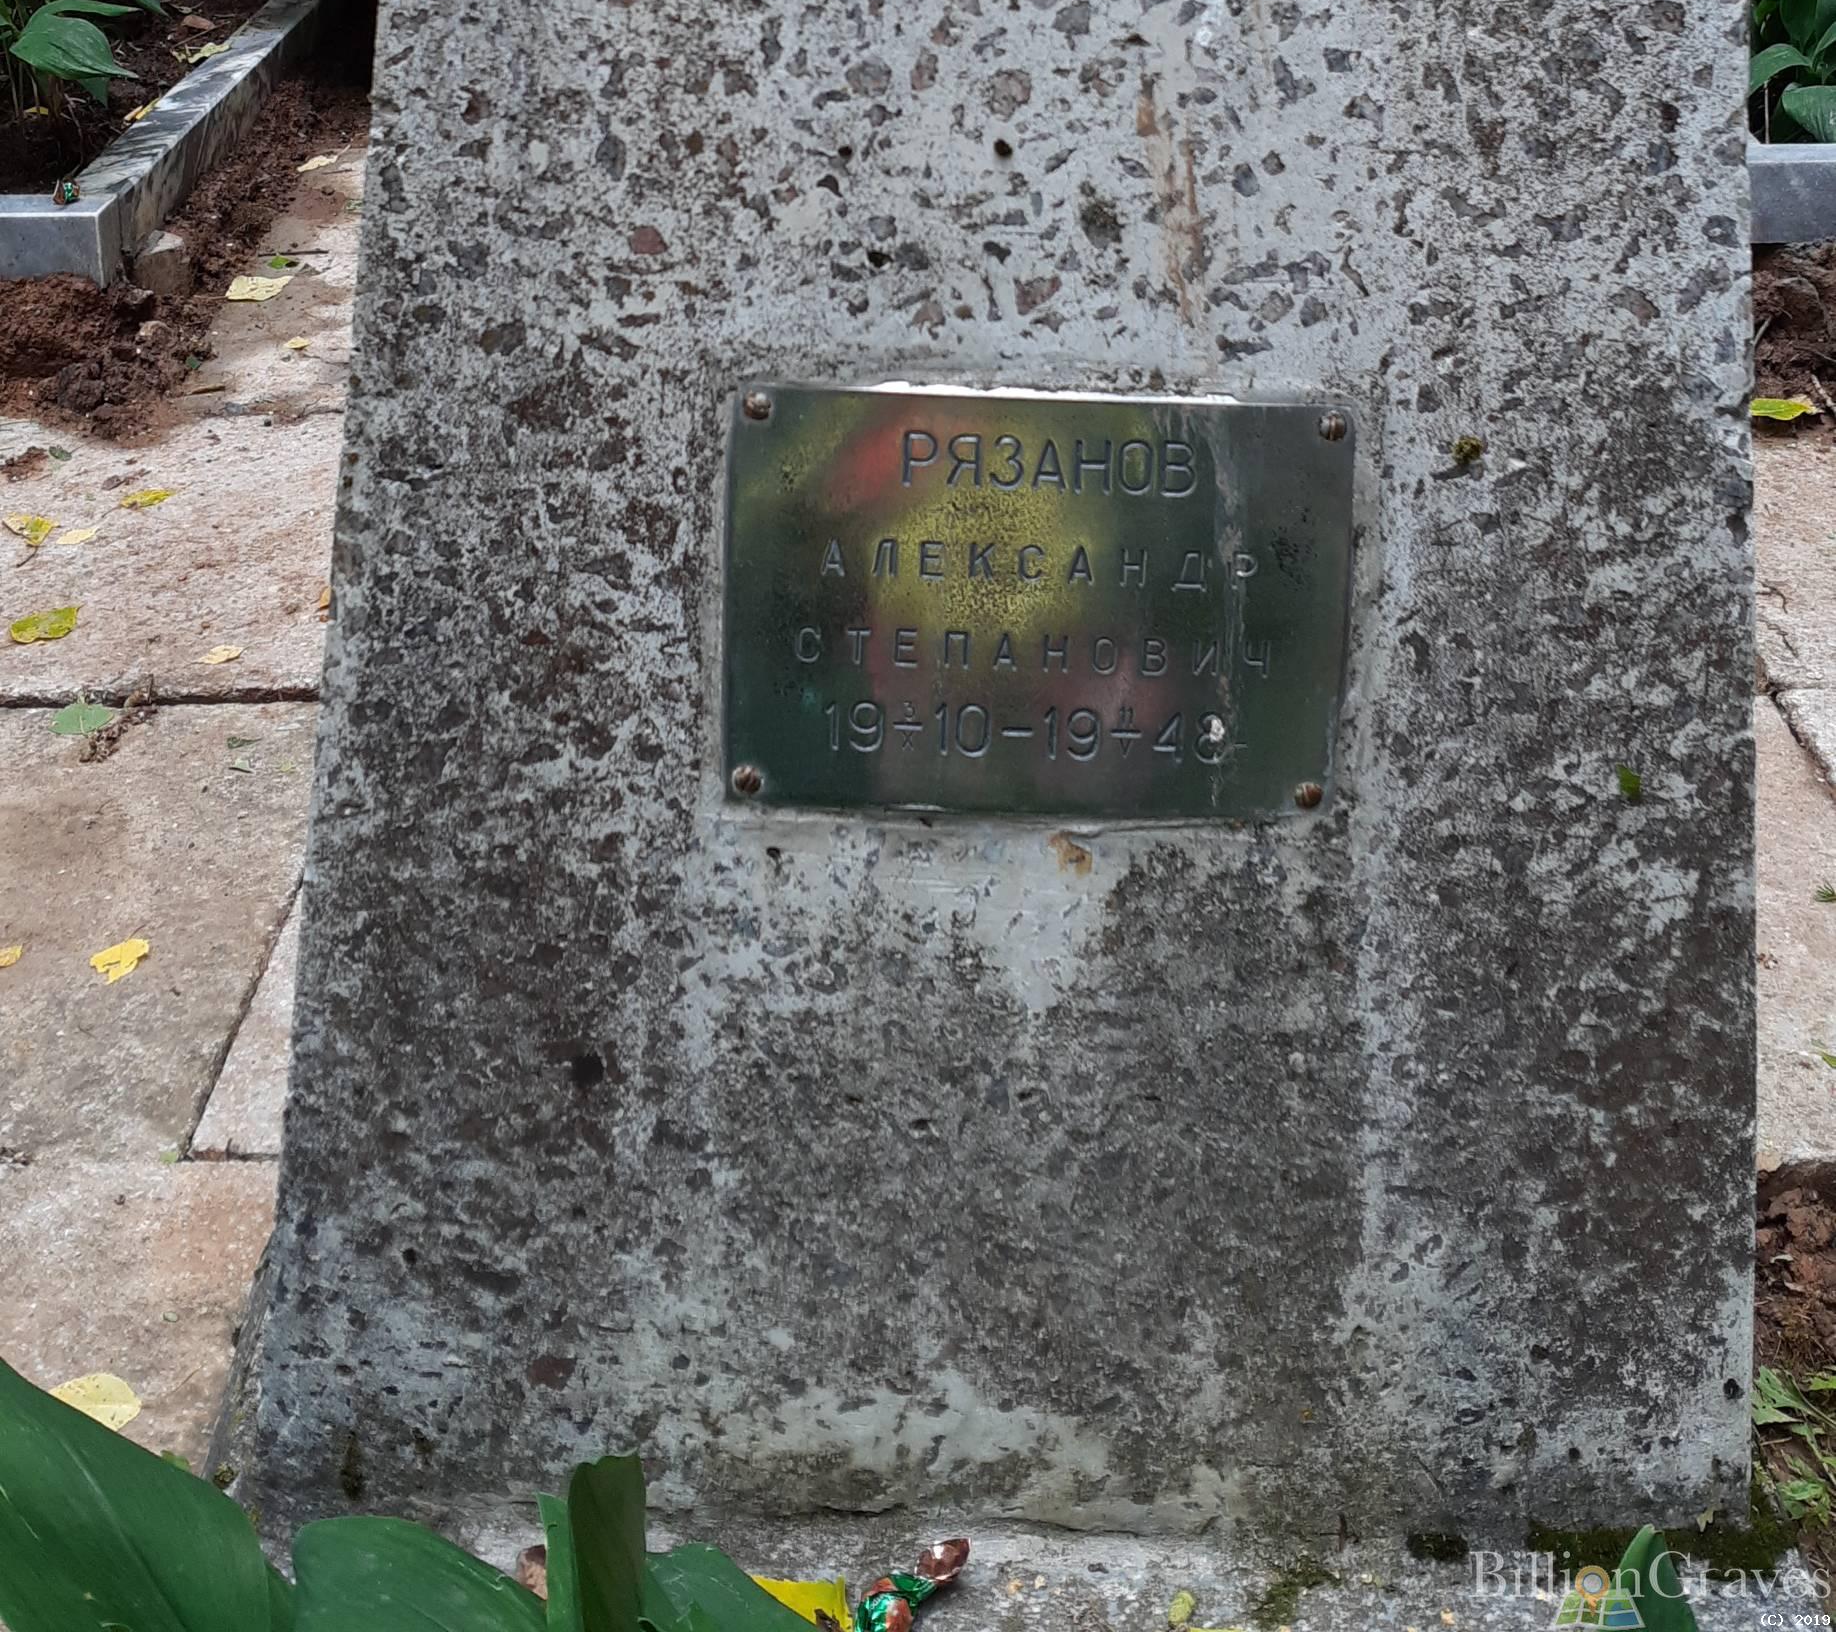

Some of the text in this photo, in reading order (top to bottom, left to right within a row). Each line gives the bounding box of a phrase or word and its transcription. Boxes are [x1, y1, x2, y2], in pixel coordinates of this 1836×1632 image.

[901, 430, 1198, 498] РЯЗАНОВ
[820, 537, 1260, 593] АЛЕКСАНДР
[794, 626, 1273, 679] СТЕПАНОВИЧ
